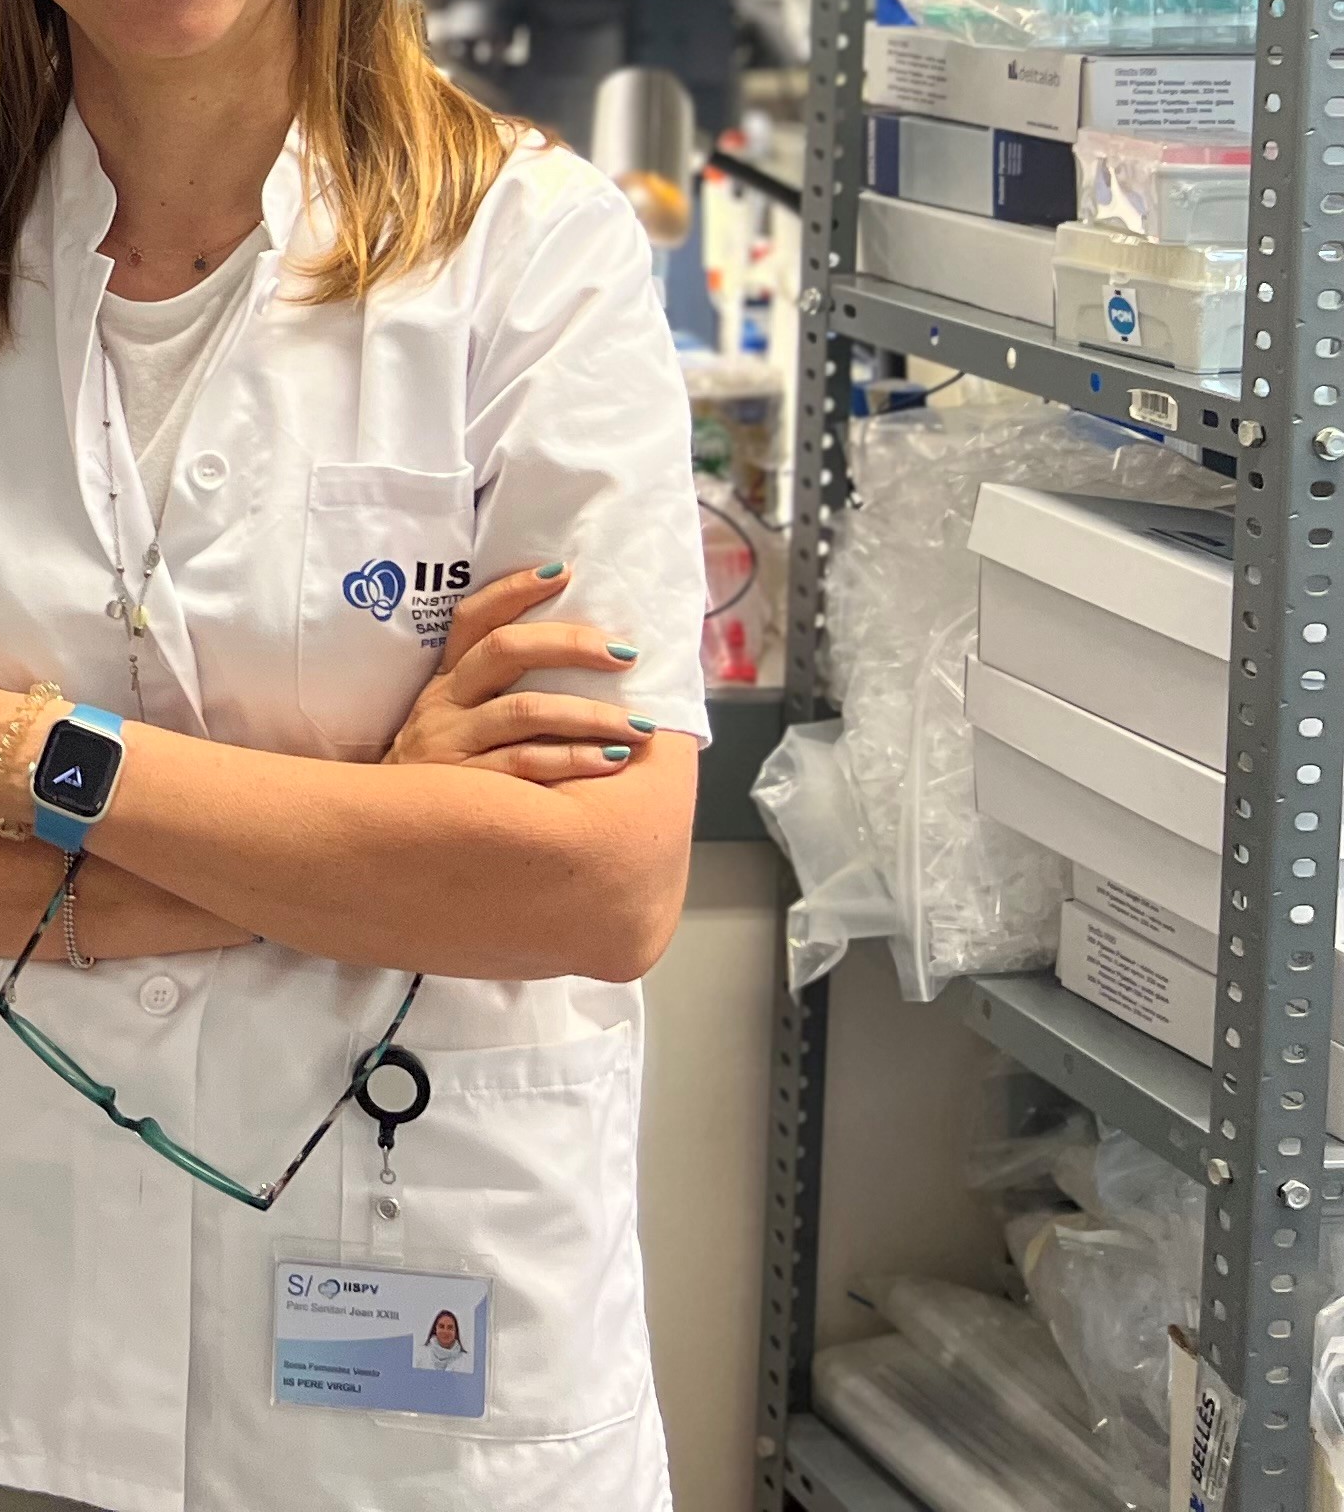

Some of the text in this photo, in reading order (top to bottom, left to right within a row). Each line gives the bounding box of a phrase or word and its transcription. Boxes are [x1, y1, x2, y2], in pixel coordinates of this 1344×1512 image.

[415, 560, 471, 592] IIS
[412, 594, 465, 606] INSTIT
[421, 637, 447, 649] PER
[343, 1281, 380, 1295] IISPV
[286, 1300, 309, 1313] Parc
[349, 1305, 374, 1318] Joan
[297, 1377, 324, 1390] PERE
